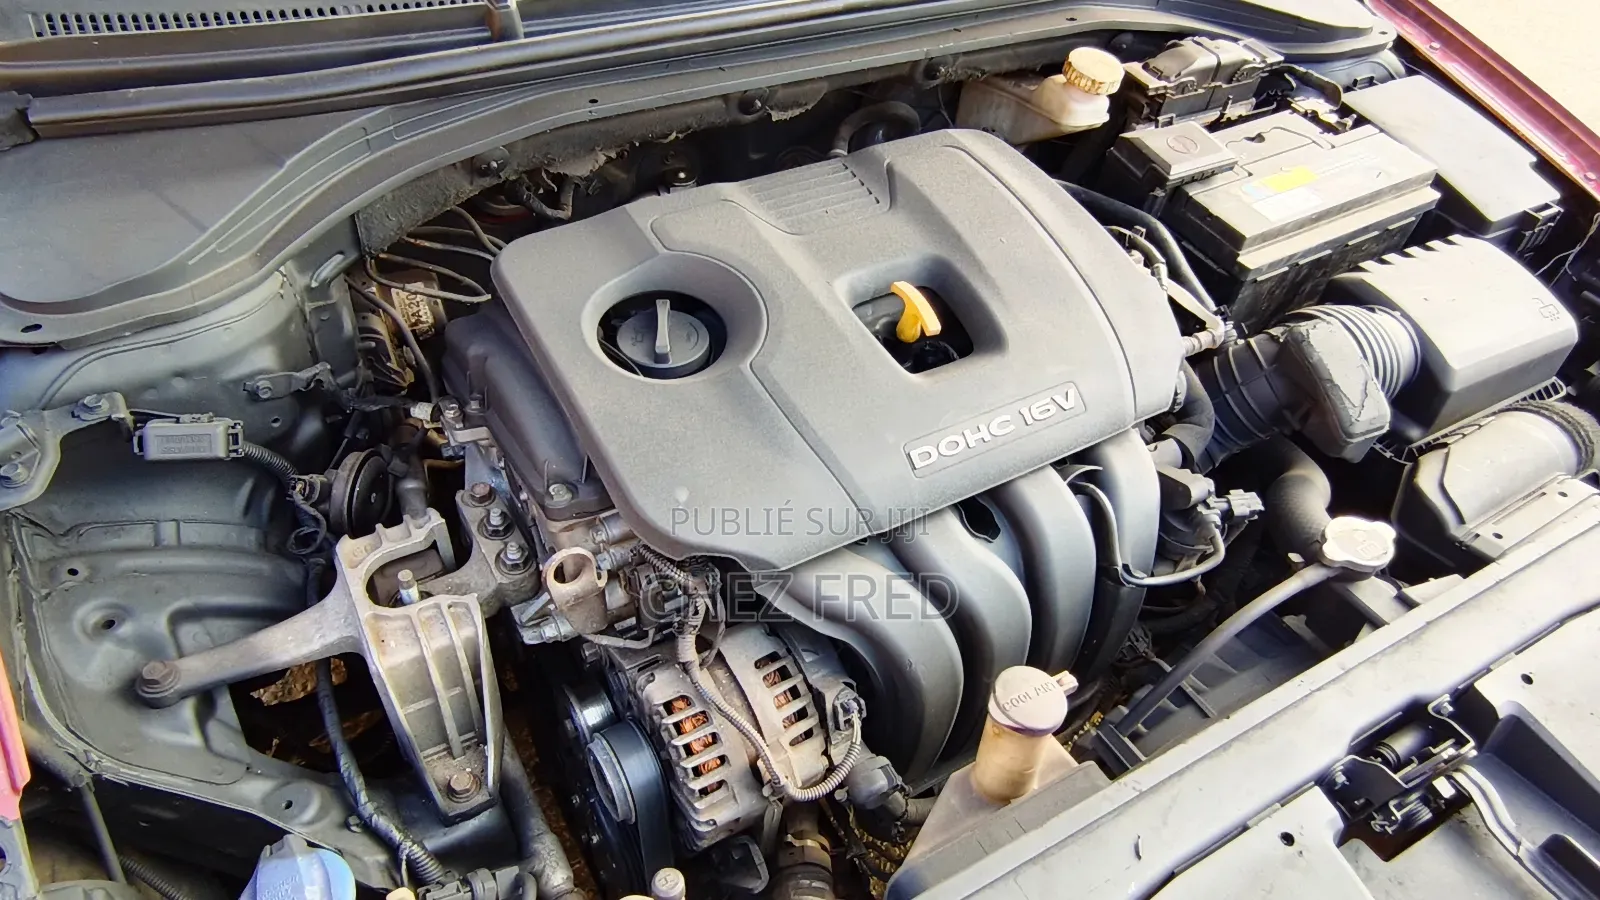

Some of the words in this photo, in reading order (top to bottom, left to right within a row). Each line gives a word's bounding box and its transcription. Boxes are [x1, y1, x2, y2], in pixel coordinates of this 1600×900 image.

[908, 415, 1016, 470] DOHC
[1019, 388, 1075, 426] 16V
[1002, 681, 1057, 712] COOLANT
